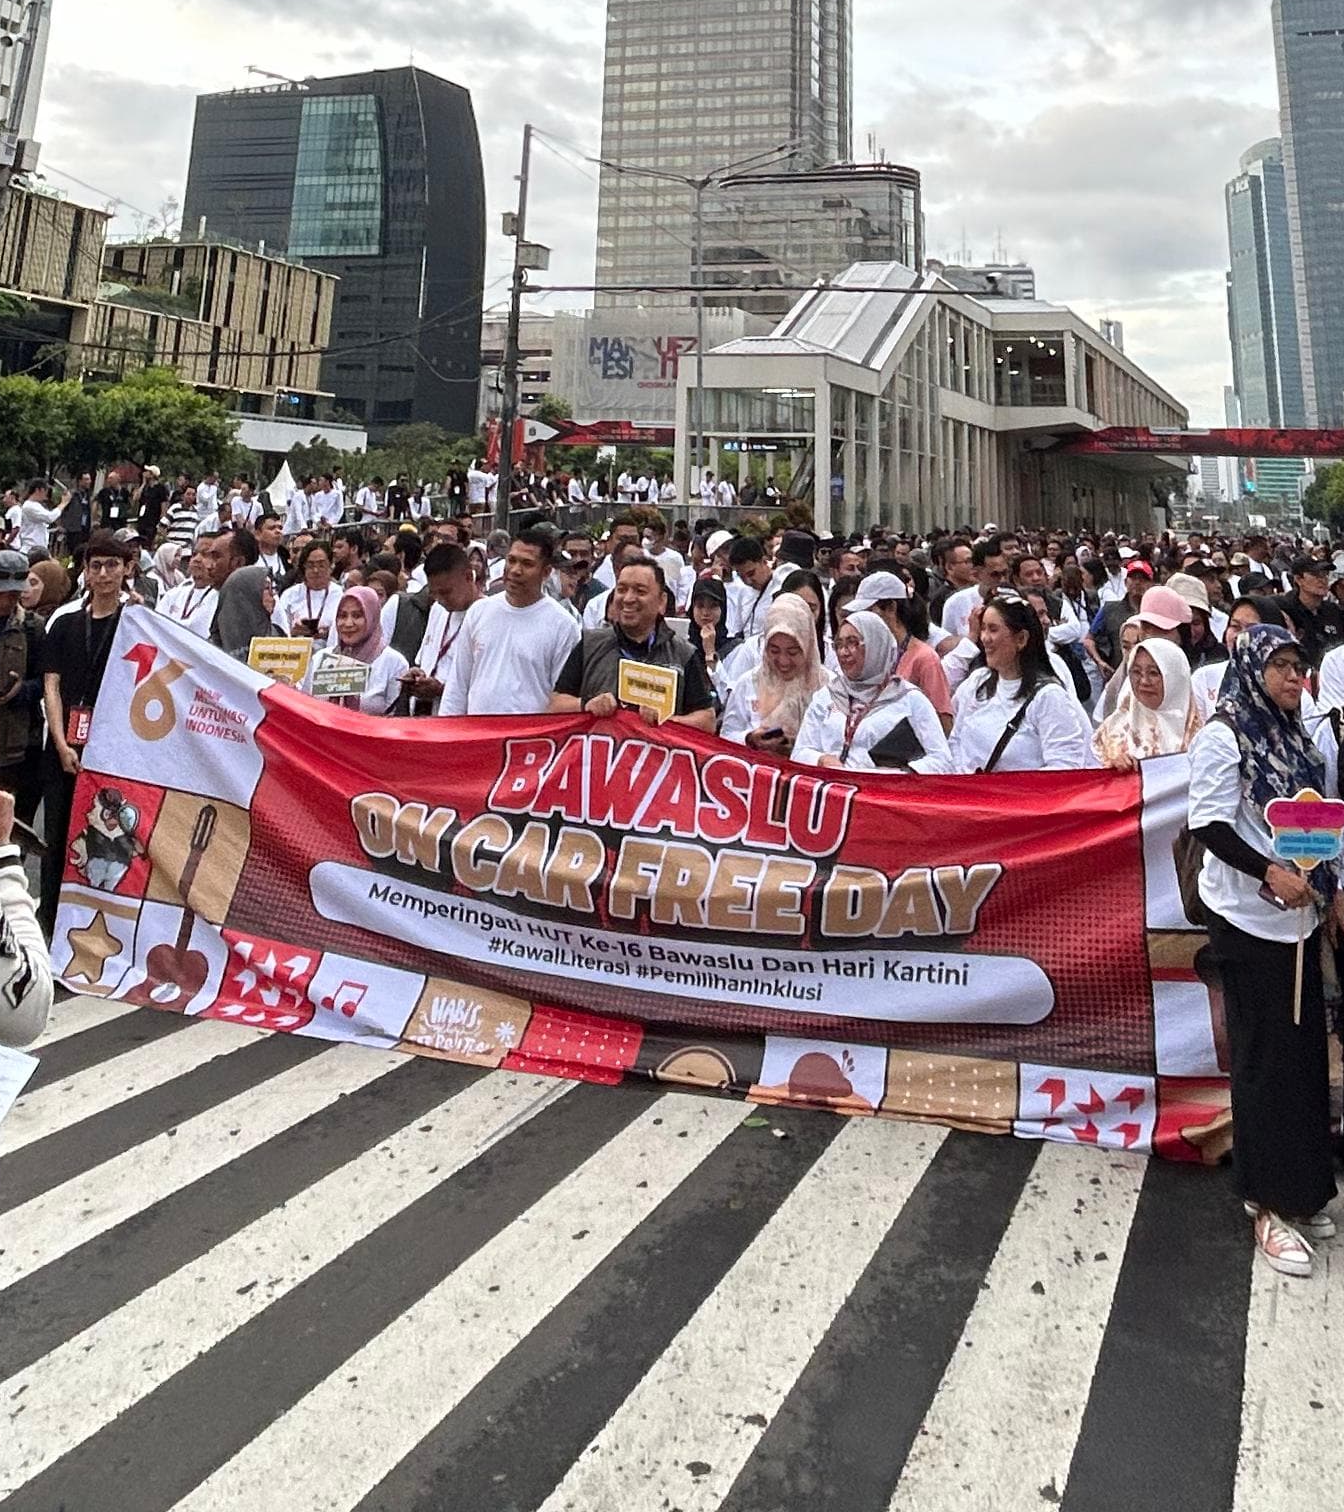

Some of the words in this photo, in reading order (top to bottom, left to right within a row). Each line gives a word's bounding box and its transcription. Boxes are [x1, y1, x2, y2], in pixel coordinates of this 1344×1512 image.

[186, 718, 248, 744] INDONESIA
[189, 705, 228, 724] UNTUK
[487, 735, 858, 858] BAWASLU
[351, 792, 456, 872] ON
[451, 813, 605, 913] CAR
[609, 836, 816, 935] FREE
[821, 862, 1003, 938] DAY
[368, 883, 523, 931] Memperingati
[527, 922, 572, 942] HUT
[579, 933, 642, 958] Ke-16
[648, 945, 754, 971] Bawaslu
[762, 956, 816, 974] Dan
[822, 957, 875, 979] Hari
[883, 960, 970, 986] Kartini
[488, 936, 631, 976] #KawalLiterasi
[637, 962, 824, 1001] #PemilihanInklusi
